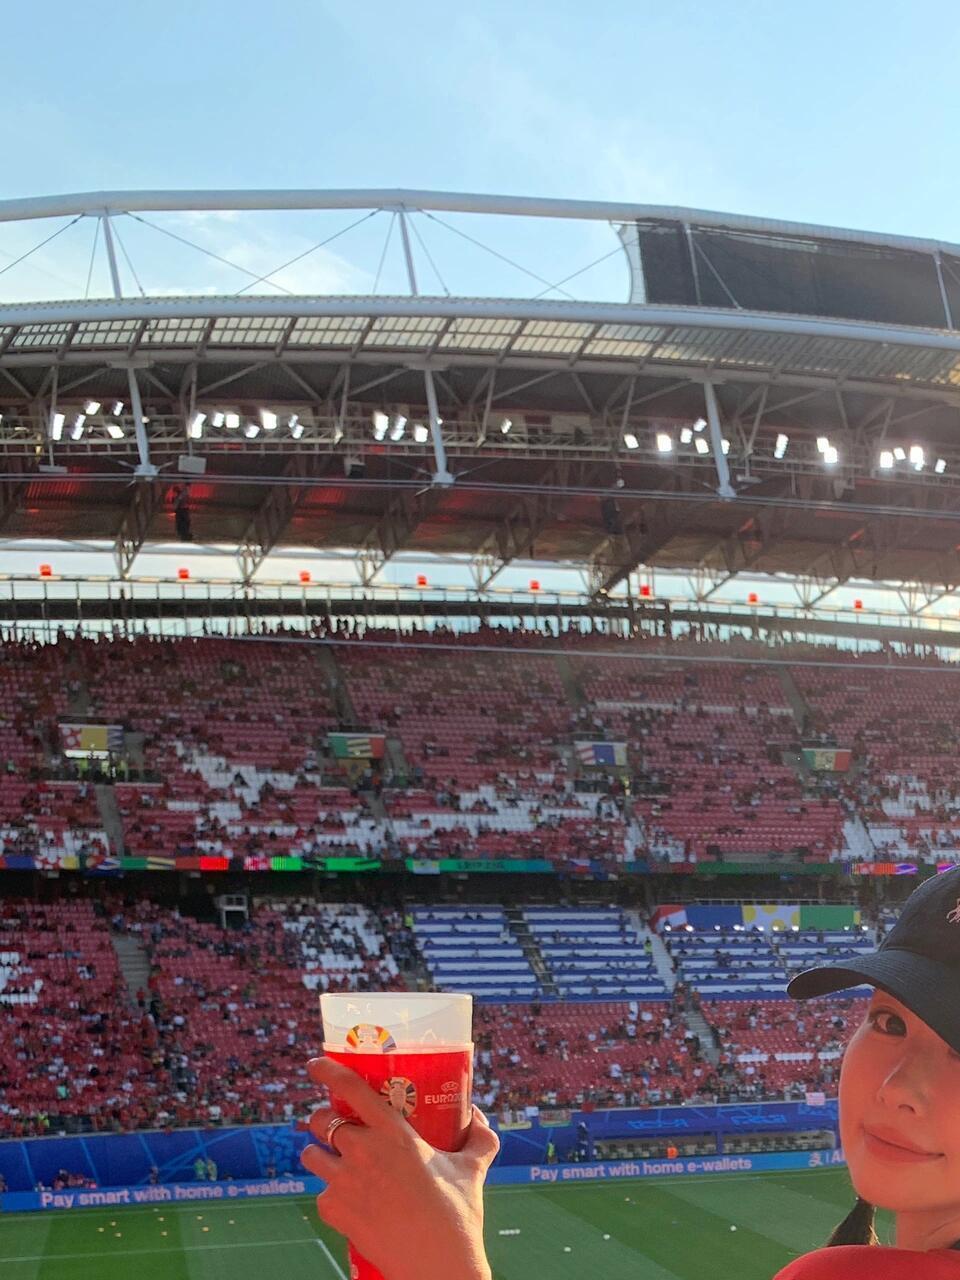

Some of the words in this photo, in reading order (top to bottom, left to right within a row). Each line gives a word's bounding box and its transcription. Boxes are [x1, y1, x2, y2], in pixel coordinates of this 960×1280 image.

[531, 1166, 558, 1182] Pay
[562, 1164, 606, 1179] smart
[608, 1162, 640, 1176] with
[643, 1161, 684, 1175] home
[687, 1157, 752, 1173] e-wallets
[41, 1191, 74, 1209] Pay
[79, 1189, 131, 1206] smart
[134, 1185, 171, 1203] with
[175, 1184, 224, 1200] home
[226, 1180, 306, 1198] e-wallets
